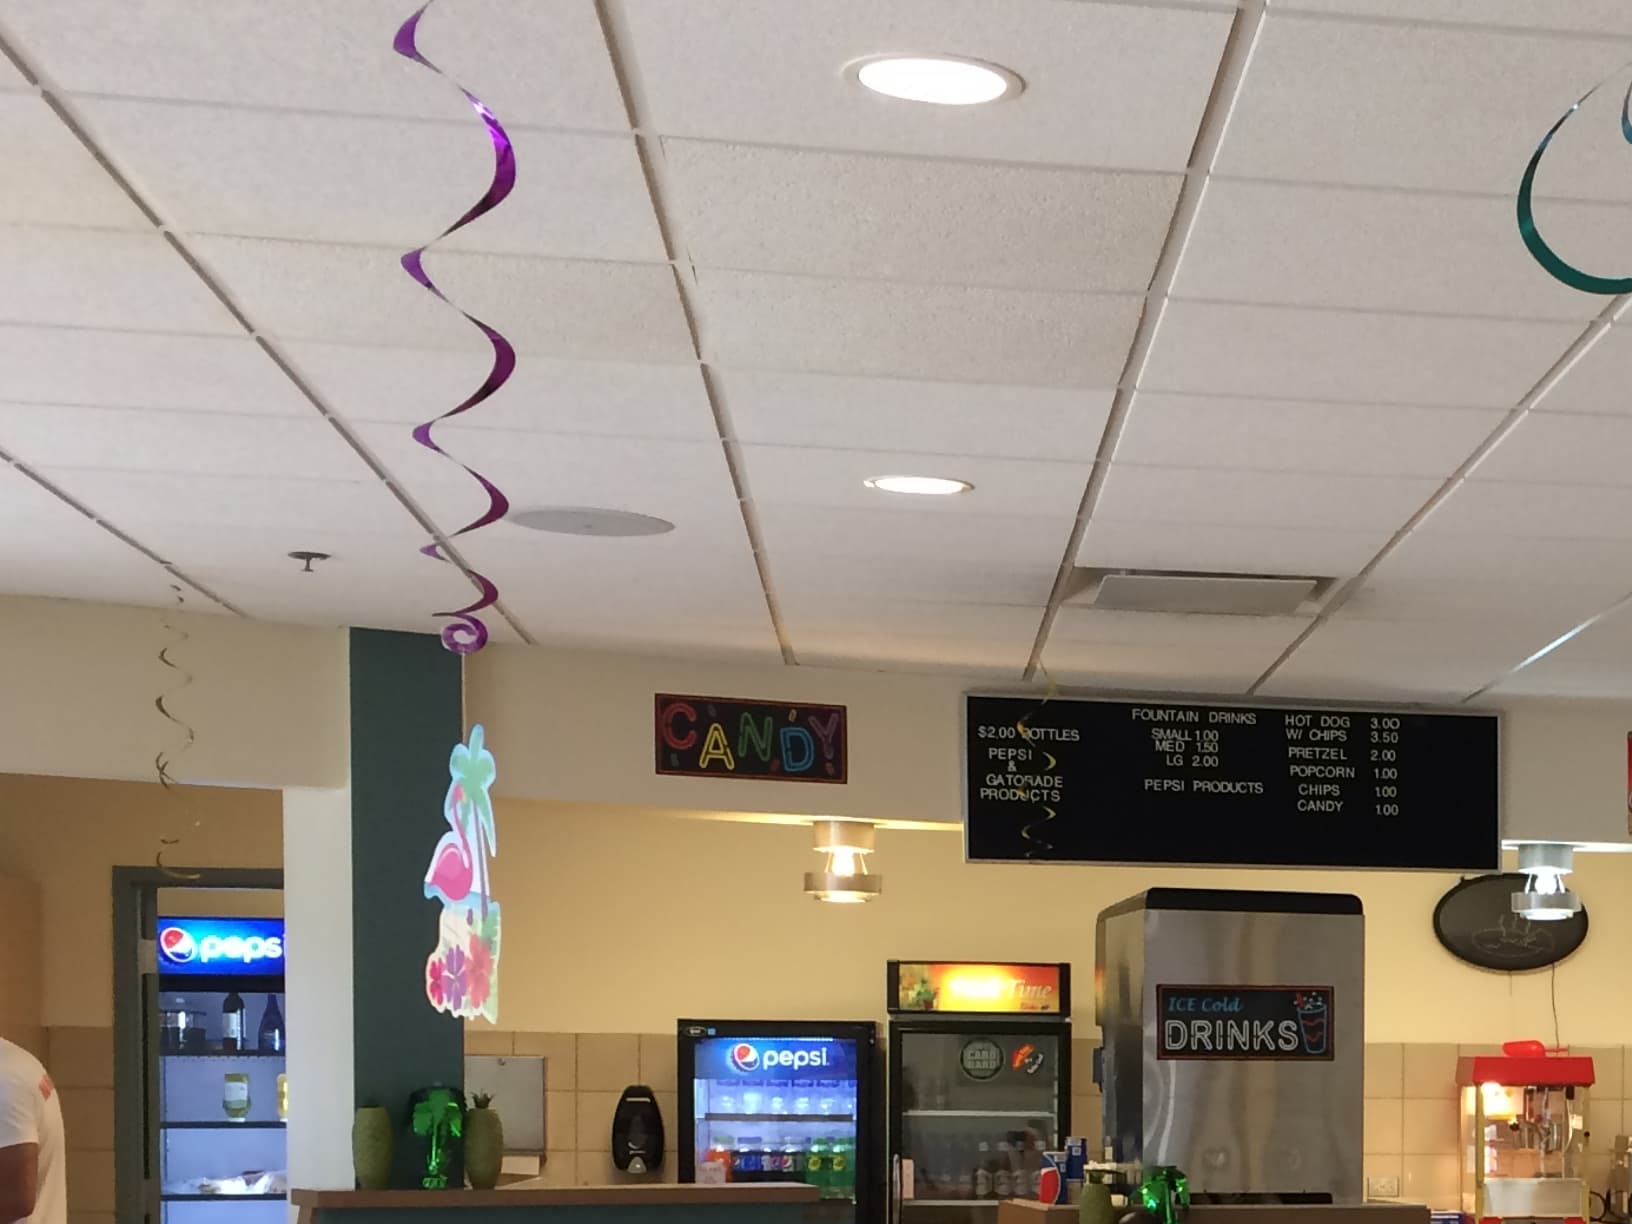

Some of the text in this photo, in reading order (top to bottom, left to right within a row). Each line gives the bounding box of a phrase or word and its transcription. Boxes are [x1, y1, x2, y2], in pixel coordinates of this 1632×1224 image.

[1131, 708, 1257, 725] FOUNTAIN DRINKS
[1285, 714, 1400, 729] HOT DOG 3.00
[662, 702, 840, 772] CANDY
[977, 725, 1016, 739] $2.00
[1151, 727, 1192, 741] SMALL
[1286, 728, 1399, 743] W/ CHIPS 3.50
[988, 747, 1032, 760] PEPSI
[1155, 740, 1185, 752] MED
[1288, 746, 1396, 761] PRETZEL 2.00
[1007, 760, 1017, 772] &
[1166, 754, 1219, 767] LG 2.00
[1289, 765, 1355, 778] POPCORN
[985, 773, 1063, 788] GATORADE
[1144, 779, 1264, 794] PEPSI PRODUCTS
[979, 787, 1061, 802] PRODUCTS
[1298, 783, 1340, 796] CHIPS
[1297, 799, 1343, 812] CANDY
[200, 935, 285, 963] peps
[1168, 997, 1241, 1012] ICE Cold
[1164, 1019, 1299, 1051] DRINKS
[763, 1047, 827, 1070] pepsi
